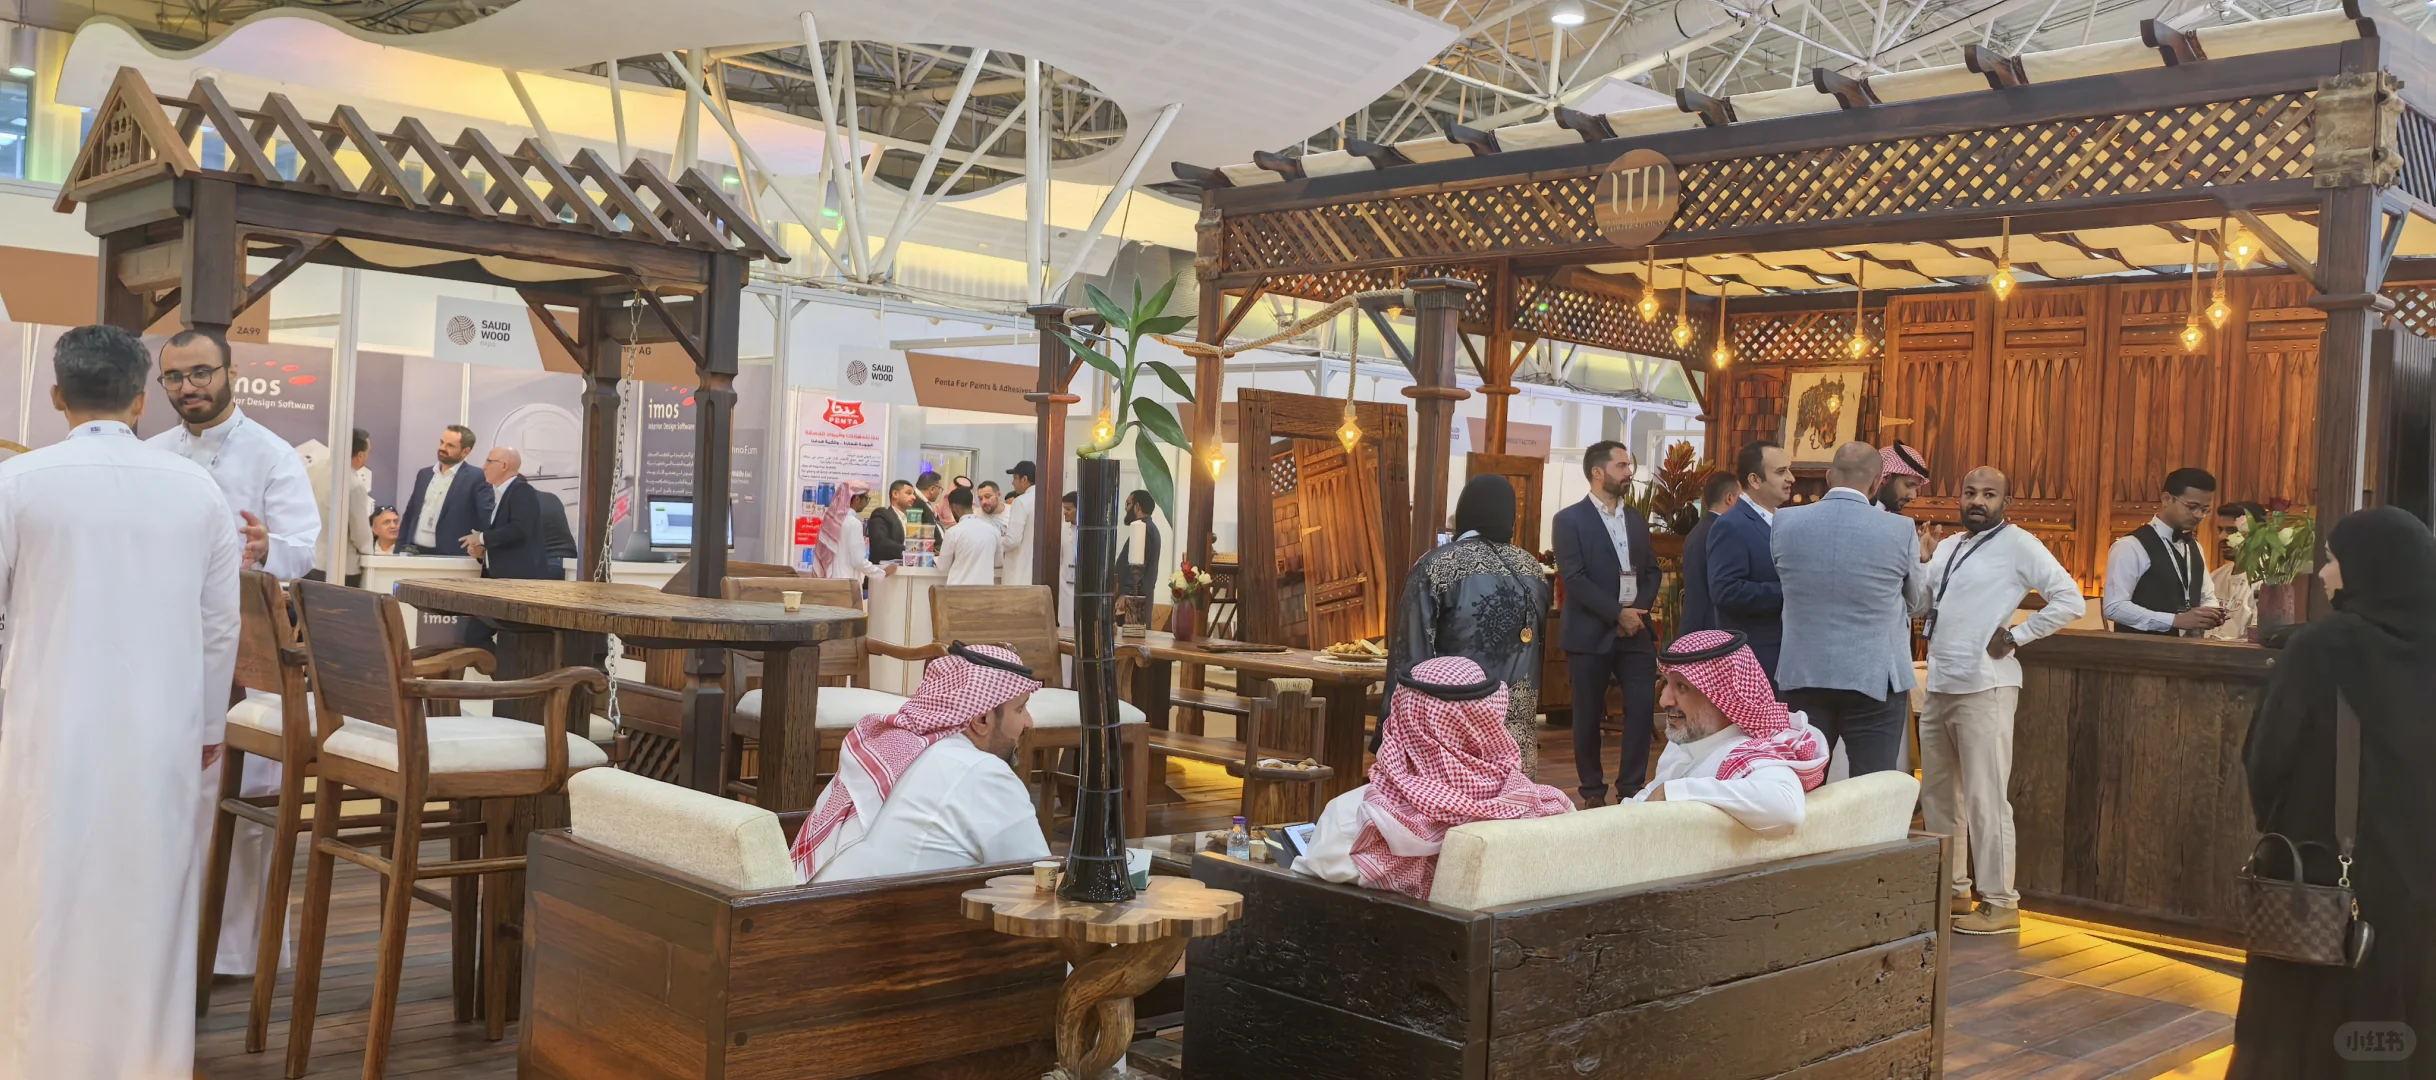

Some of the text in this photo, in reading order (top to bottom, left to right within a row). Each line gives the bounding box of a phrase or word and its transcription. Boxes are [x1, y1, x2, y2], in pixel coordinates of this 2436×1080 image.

[237, 326, 261, 336] 2A99
[481, 320, 511, 331] SAUDI
[481, 330, 511, 342] WOOD
[638, 346, 652, 355] AG
[871, 363, 894, 373] SAUDI
[871, 372, 894, 382] WOOD
[234, 376, 281, 396] mos
[934, 377, 955, 387] Penta
[956, 379, 968, 388] For
[969, 381, 991, 391] Paints
[992, 383, 998, 391] &
[247, 397, 275, 409] Design
[278, 400, 315, 410] Software
[648, 398, 680, 419] imos
[828, 416, 859, 425] PENTA
[423, 612, 458, 624] imos
